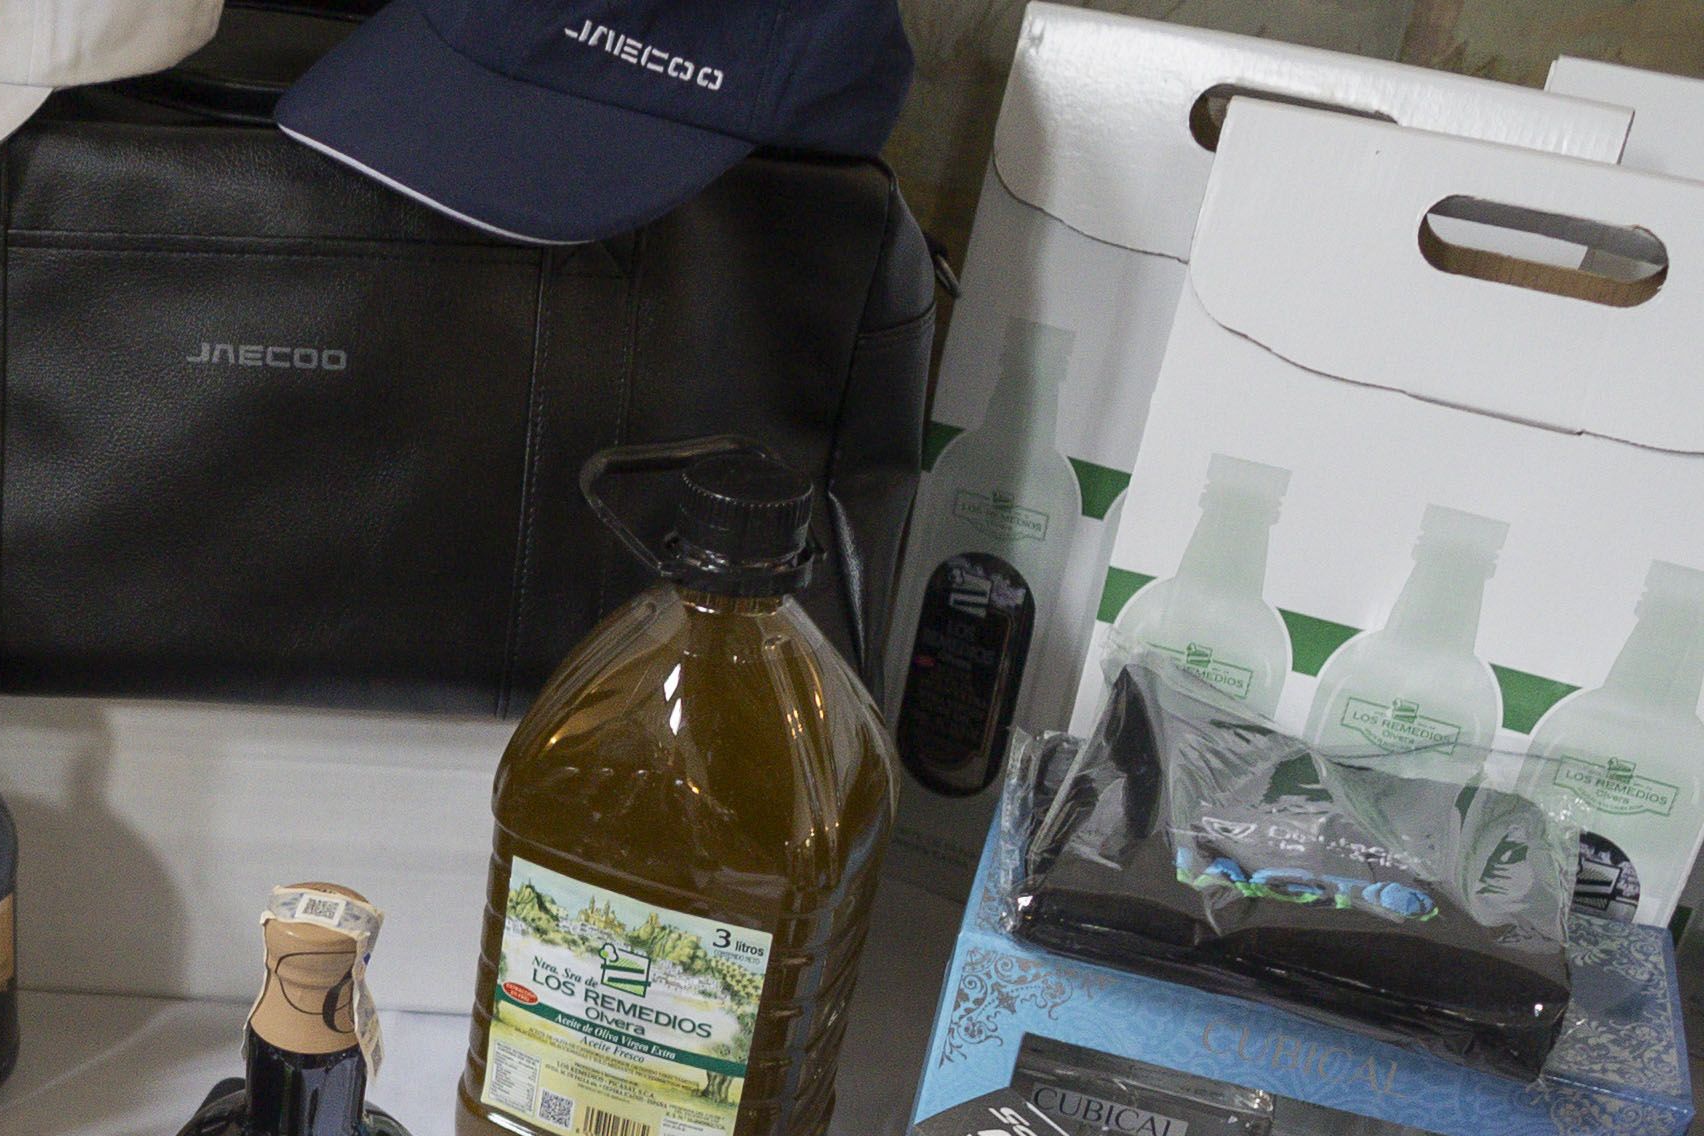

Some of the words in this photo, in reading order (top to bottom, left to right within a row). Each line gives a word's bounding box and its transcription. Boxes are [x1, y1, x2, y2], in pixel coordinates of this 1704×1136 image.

[564, 19, 724, 91] JAECOO
[186, 342, 346, 370] JAECOO
[1565, 769, 1592, 784] LOS
[1595, 779, 1669, 806] REMEDIOS
[712, 928, 732, 949] 3
[734, 941, 765, 957] litros
[532, 955, 559, 976] Ntra.
[562, 966, 582, 983] Sra
[583, 973, 598, 988] de
[532, 968, 576, 997] LOS
[583, 988, 713, 1039] REMEDIOS
[585, 1006, 646, 1036] Olvera
[554, 1013, 582, 1032] Aceite
[582, 1023, 595, 1034] de
[595, 1026, 620, 1044] Oliva
[620, 1035, 649, 1053] Virgen
[651, 1045, 677, 1061] Extra
[579, 1035, 612, 1053] Aceite
[612, 1044, 646, 1063] Fresco
[1202, 1019, 1406, 1100] CUBICAL
